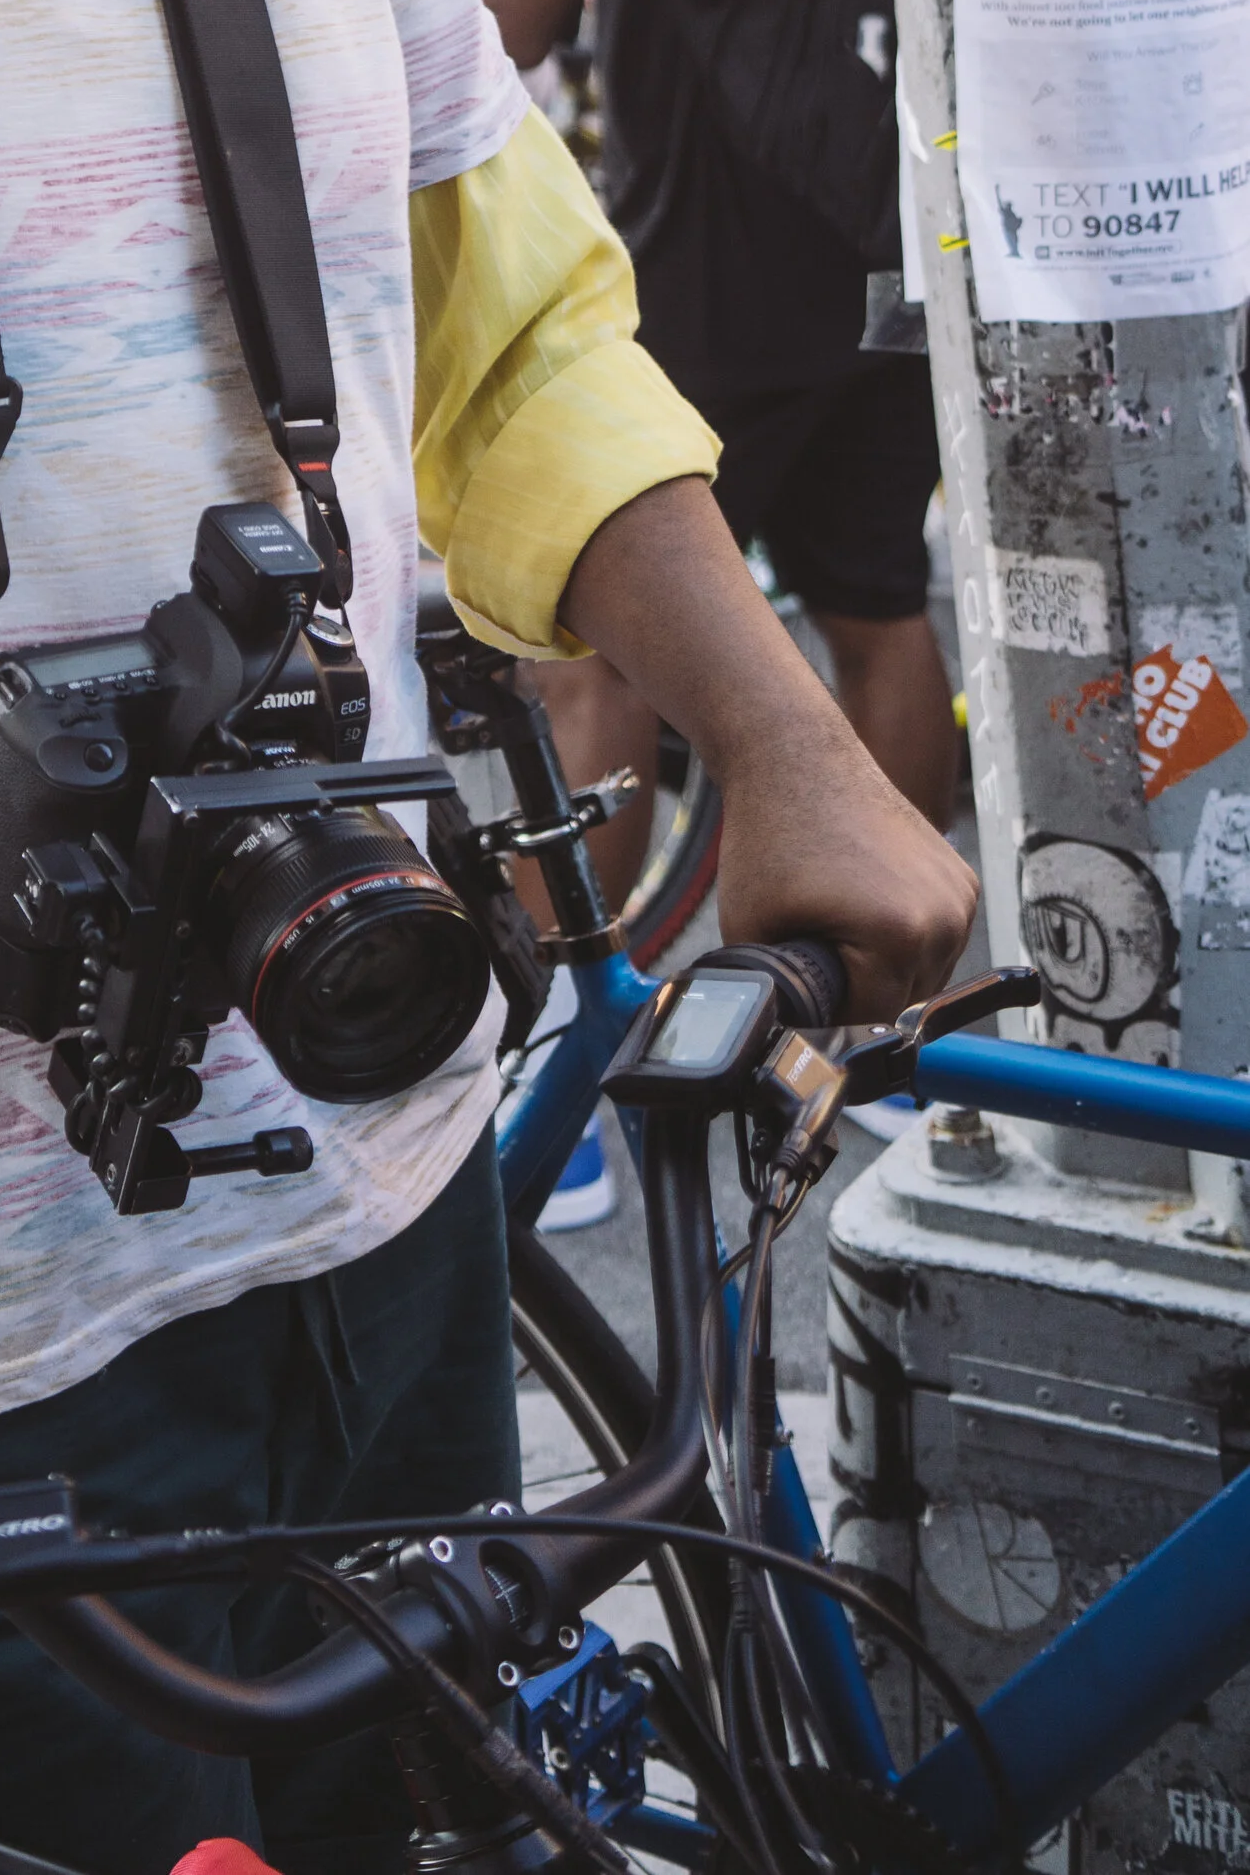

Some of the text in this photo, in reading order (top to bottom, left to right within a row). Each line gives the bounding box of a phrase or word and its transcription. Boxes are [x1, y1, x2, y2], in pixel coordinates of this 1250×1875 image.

[1007, 14, 1046, 28] We're
[1050, 16, 1072, 28] not
[1075, 14, 1111, 30] going
[1114, 13, 1126, 23] to
[1129, 10, 1144, 22] let
[1034, 182, 1110, 208] TEXT
[1145, 173, 1216, 203] WILL
[1034, 210, 1181, 239] TO 90847
[254, 689, 316, 710] anon
[340, 696, 367, 716] EOS
[1146, 659, 1212, 749] CLUB
[344, 727, 361, 743] 5D
[232, 822, 277, 858] 24-105mm
[305, 915, 316, 925] IS
[283, 928, 301, 950] USM
